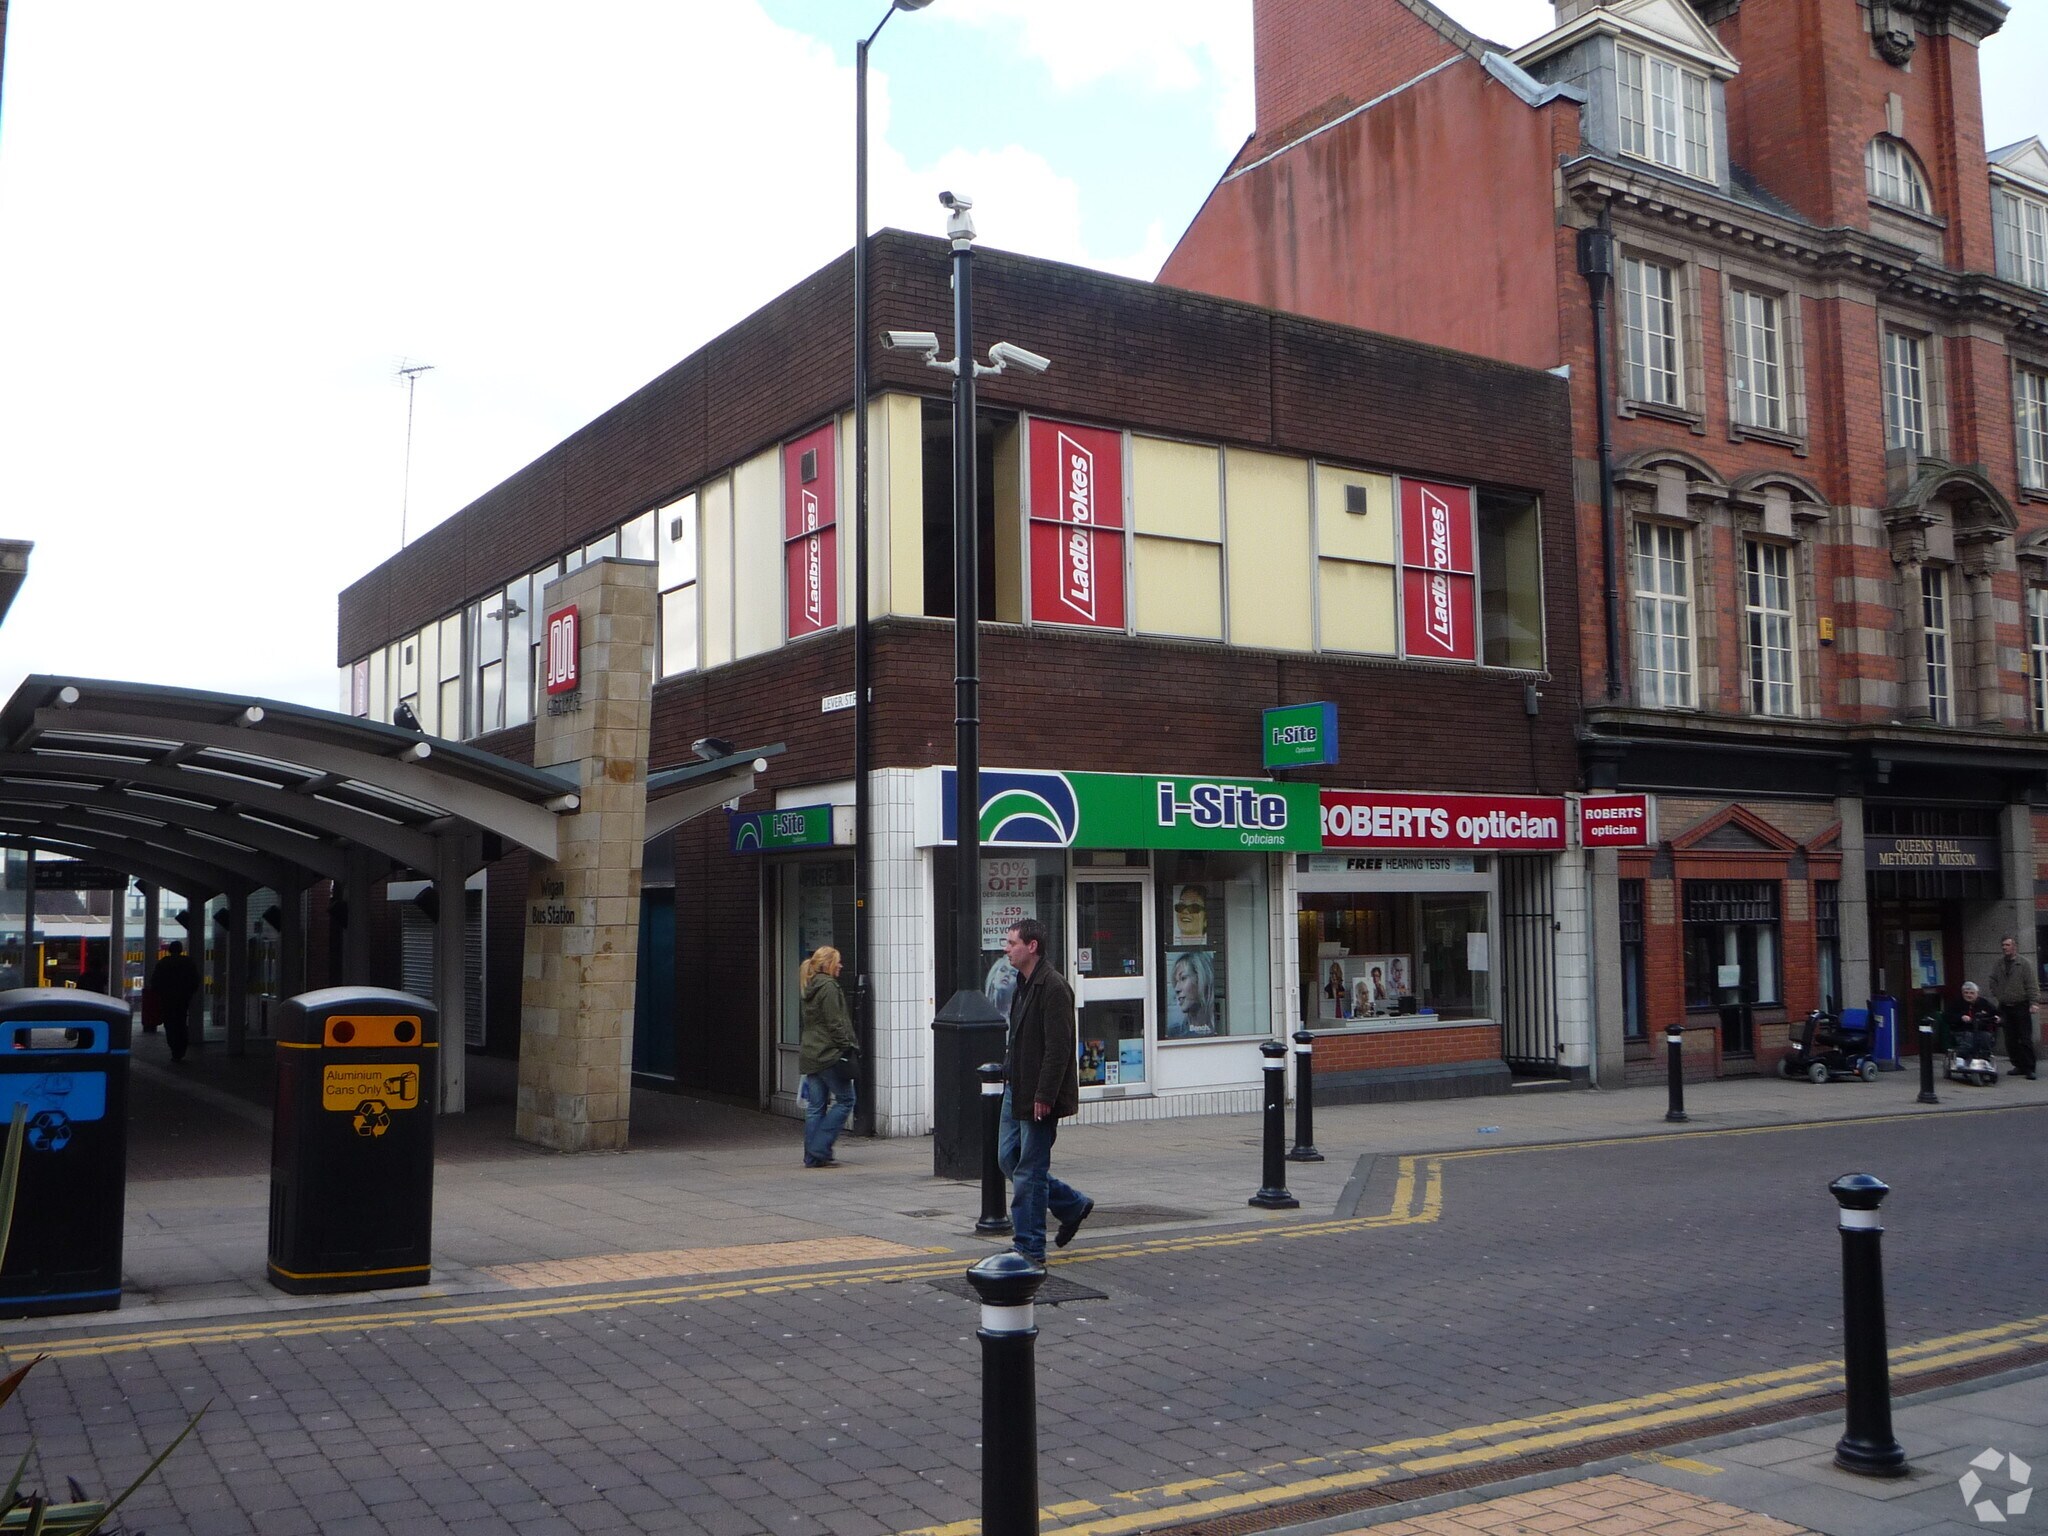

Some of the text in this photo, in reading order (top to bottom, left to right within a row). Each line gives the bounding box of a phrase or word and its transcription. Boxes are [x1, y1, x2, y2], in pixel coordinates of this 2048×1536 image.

[1069, 454, 1089, 602] Ladbrokes
[1431, 506, 1449, 635] Ladbrokes
[824, 696, 844, 710] LEVER
[1272, 725, 1318, 745] i-Site
[1157, 781, 1288, 830] i-Site
[1585, 807, 1643, 820] ROBERTS
[773, 812, 805, 837] i-Site
[1456, 810, 1558, 844] optician
[1591, 824, 1637, 837] optician
[1240, 832, 1285, 846] Opticians
[1895, 839, 1960, 853] QUEENS HALL
[1346, 858, 1383, 870] FREE
[1385, 858, 1423, 870] HEARING
[1425, 858, 1450, 870] TESTS
[1879, 853, 1976, 865] METHODIST MISSION
[989, 861, 1030, 877] 50%
[988, 877, 1029, 891] OFF
[532, 905, 575, 924] Bus Station
[1004, 907, 1022, 915] £59
[985, 917, 999, 925] £15
[1000, 917, 1020, 925] WITH
[983, 926, 999, 934] NHS
[327, 1070, 382, 1080] Aluminium
[326, 1084, 382, 1096] Cans Only
